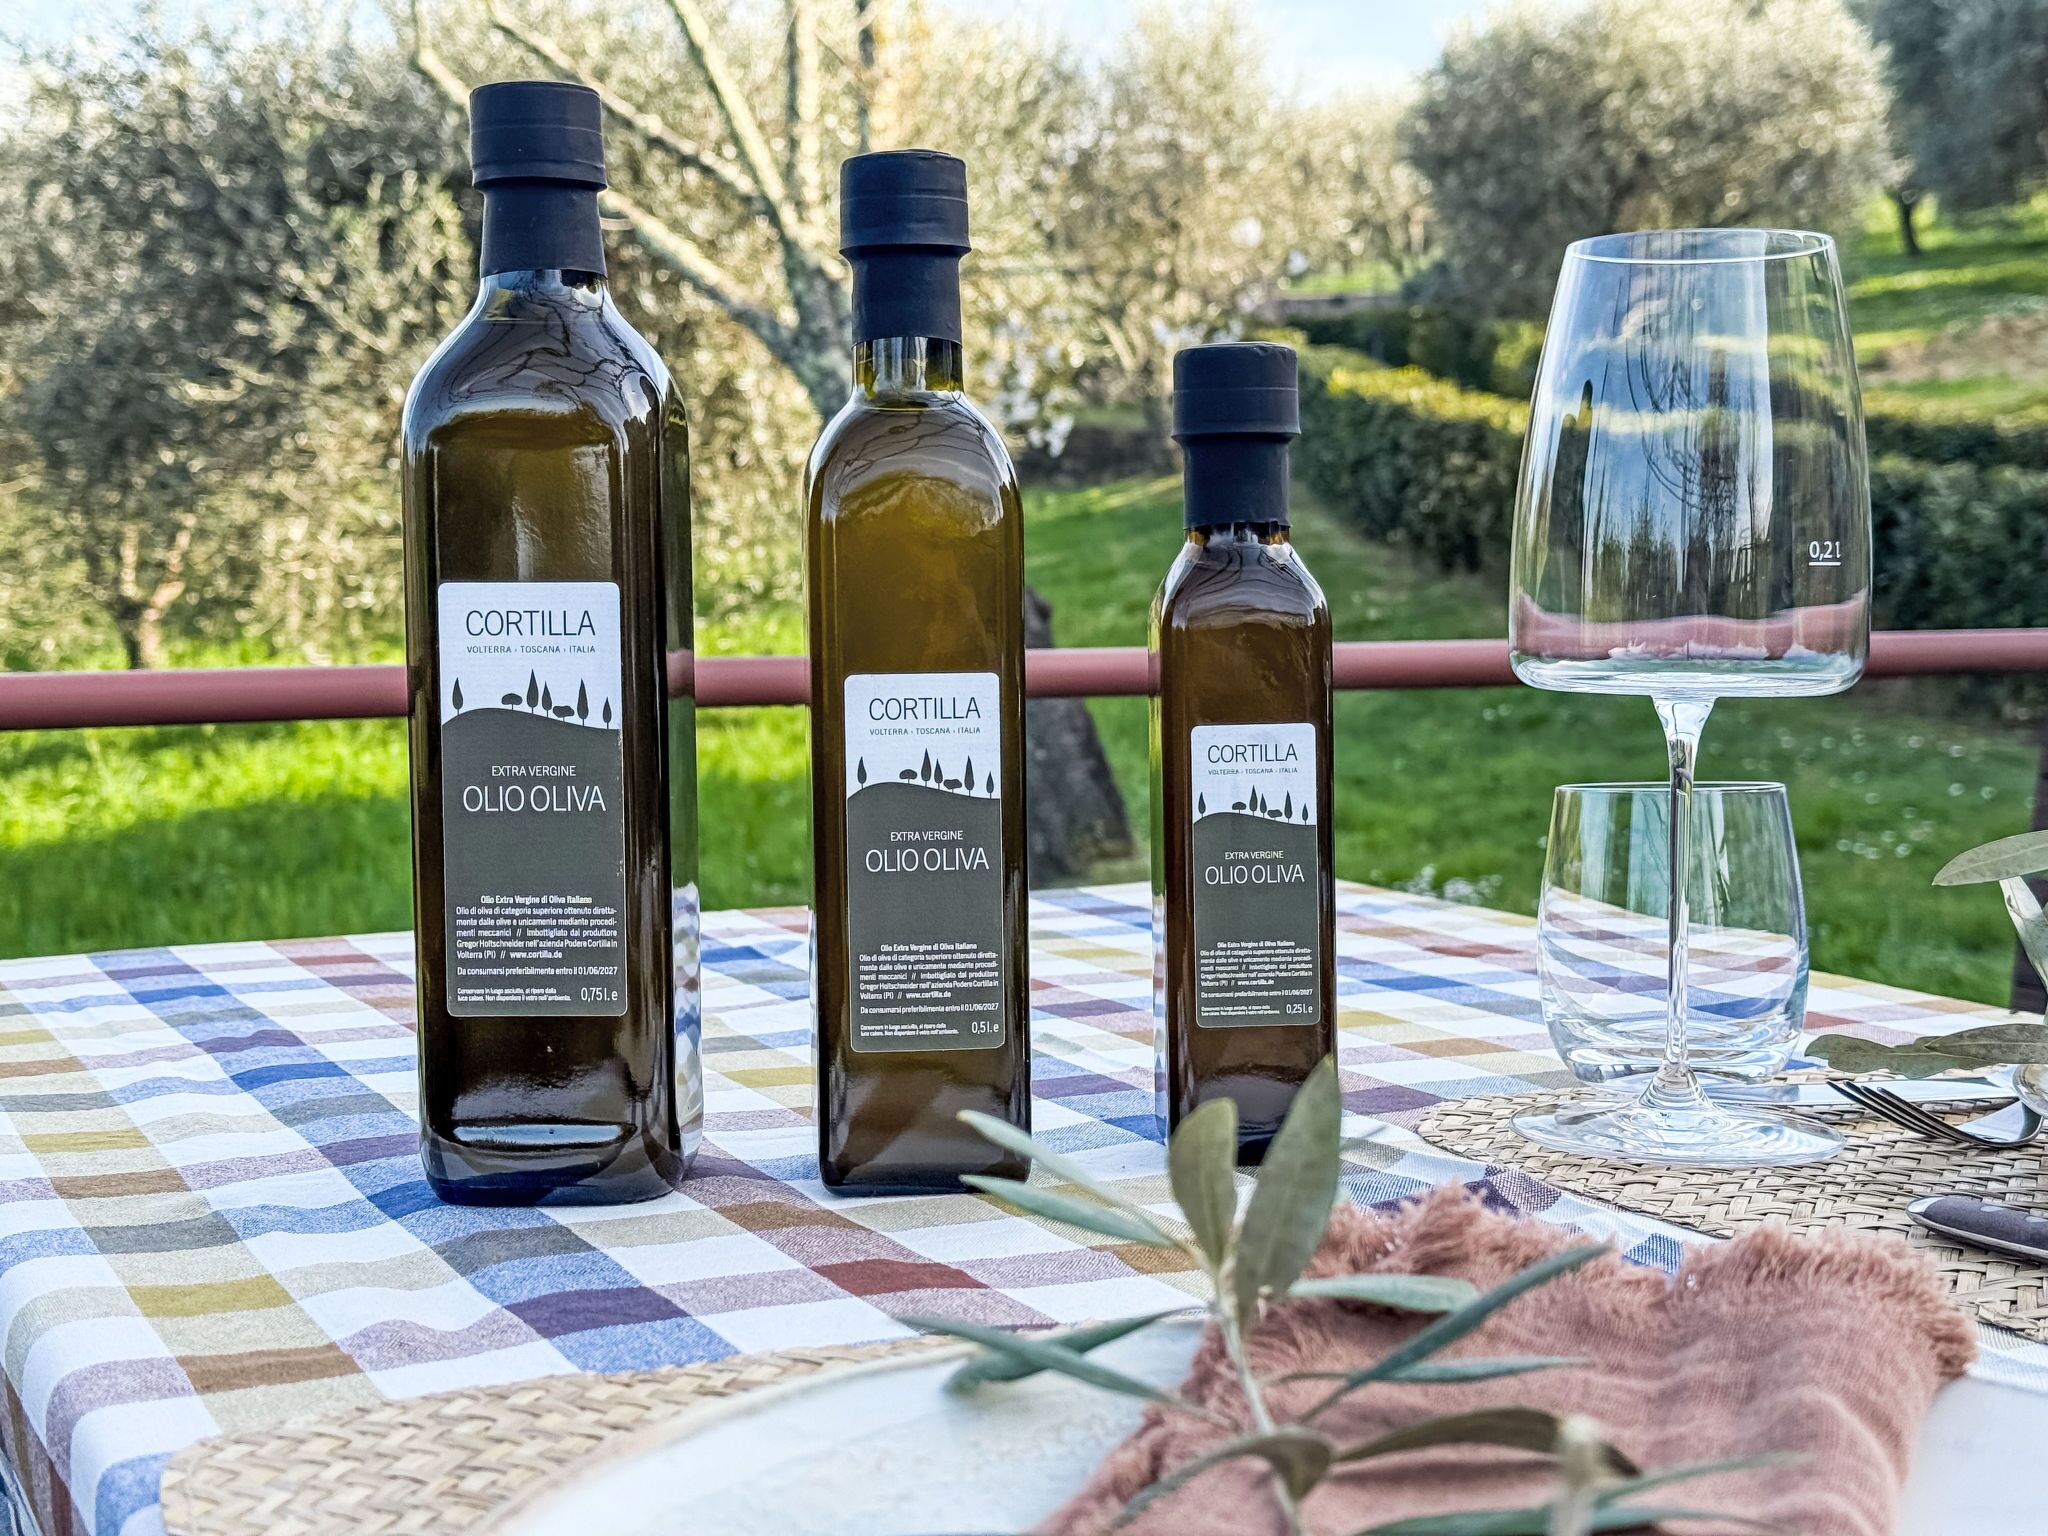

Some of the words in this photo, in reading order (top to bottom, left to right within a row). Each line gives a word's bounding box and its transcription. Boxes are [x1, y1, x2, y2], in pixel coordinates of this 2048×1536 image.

[466, 610, 596, 636] CORTILLA
[869, 697, 981, 720] CORTILLA
[916, 727, 951, 735] TOSCANA
[1208, 744, 1298, 763] CORTILLA
[492, 766, 527, 777] EXTRA
[528, 766, 576, 777] VERGINE
[463, 785, 525, 812] OLIO
[530, 785, 606, 812] OLIVA
[890, 831, 920, 841] EXTRA
[922, 830, 964, 841] VERGINE
[866, 848, 919, 872] OLIO
[924, 847, 990, 871] OLIVA
[1225, 851, 1249, 860] EXTRA
[1251, 851, 1284, 859] VERGINE
[1205, 865, 1248, 885] OLIO
[1252, 864, 1305, 884] OLIVA
[481, 895, 495, 904] Olio
[496, 895, 514, 904] Extra
[514, 895, 540, 905] Vergine
[541, 895, 548, 904] di
[548, 895, 566, 904] Oliva
[456, 907, 469, 915] Olio
[470, 907, 476, 915] di
[478, 907, 493, 915] oliva
[494, 907, 500, 915] di
[501, 907, 532, 916] categoria
[533, 907, 563, 916] superiore
[564, 907, 592, 915] ottenuto
[456, 917, 478, 926] mente
[479, 917, 495, 926] dalle
[496, 917, 511, 926] olive
[518, 917, 556, 926] unicamente
[558, 917, 589, 926] mediante
[590, 917, 618, 927] procedi-
[456, 928, 476, 937] menti
[478, 928, 512, 937] meccanici
[570, 928, 580, 937] dal
[583, 928, 618, 937] produttore
[457, 939, 479, 949] Gregor
[565, 939, 587, 948] Podere
[588, 939, 611, 948] Cortilla
[457, 950, 483, 959] Volterra
[484, 950, 496, 959] (PI)
[510, 950, 563, 959] www.cortilla.de
[457, 967, 466, 975] Da
[467, 967, 505, 975] consumarsi
[506, 967, 554, 976] preferibilmente
[556, 967, 573, 975] entro
[578, 967, 618, 975] 01/06/2027
